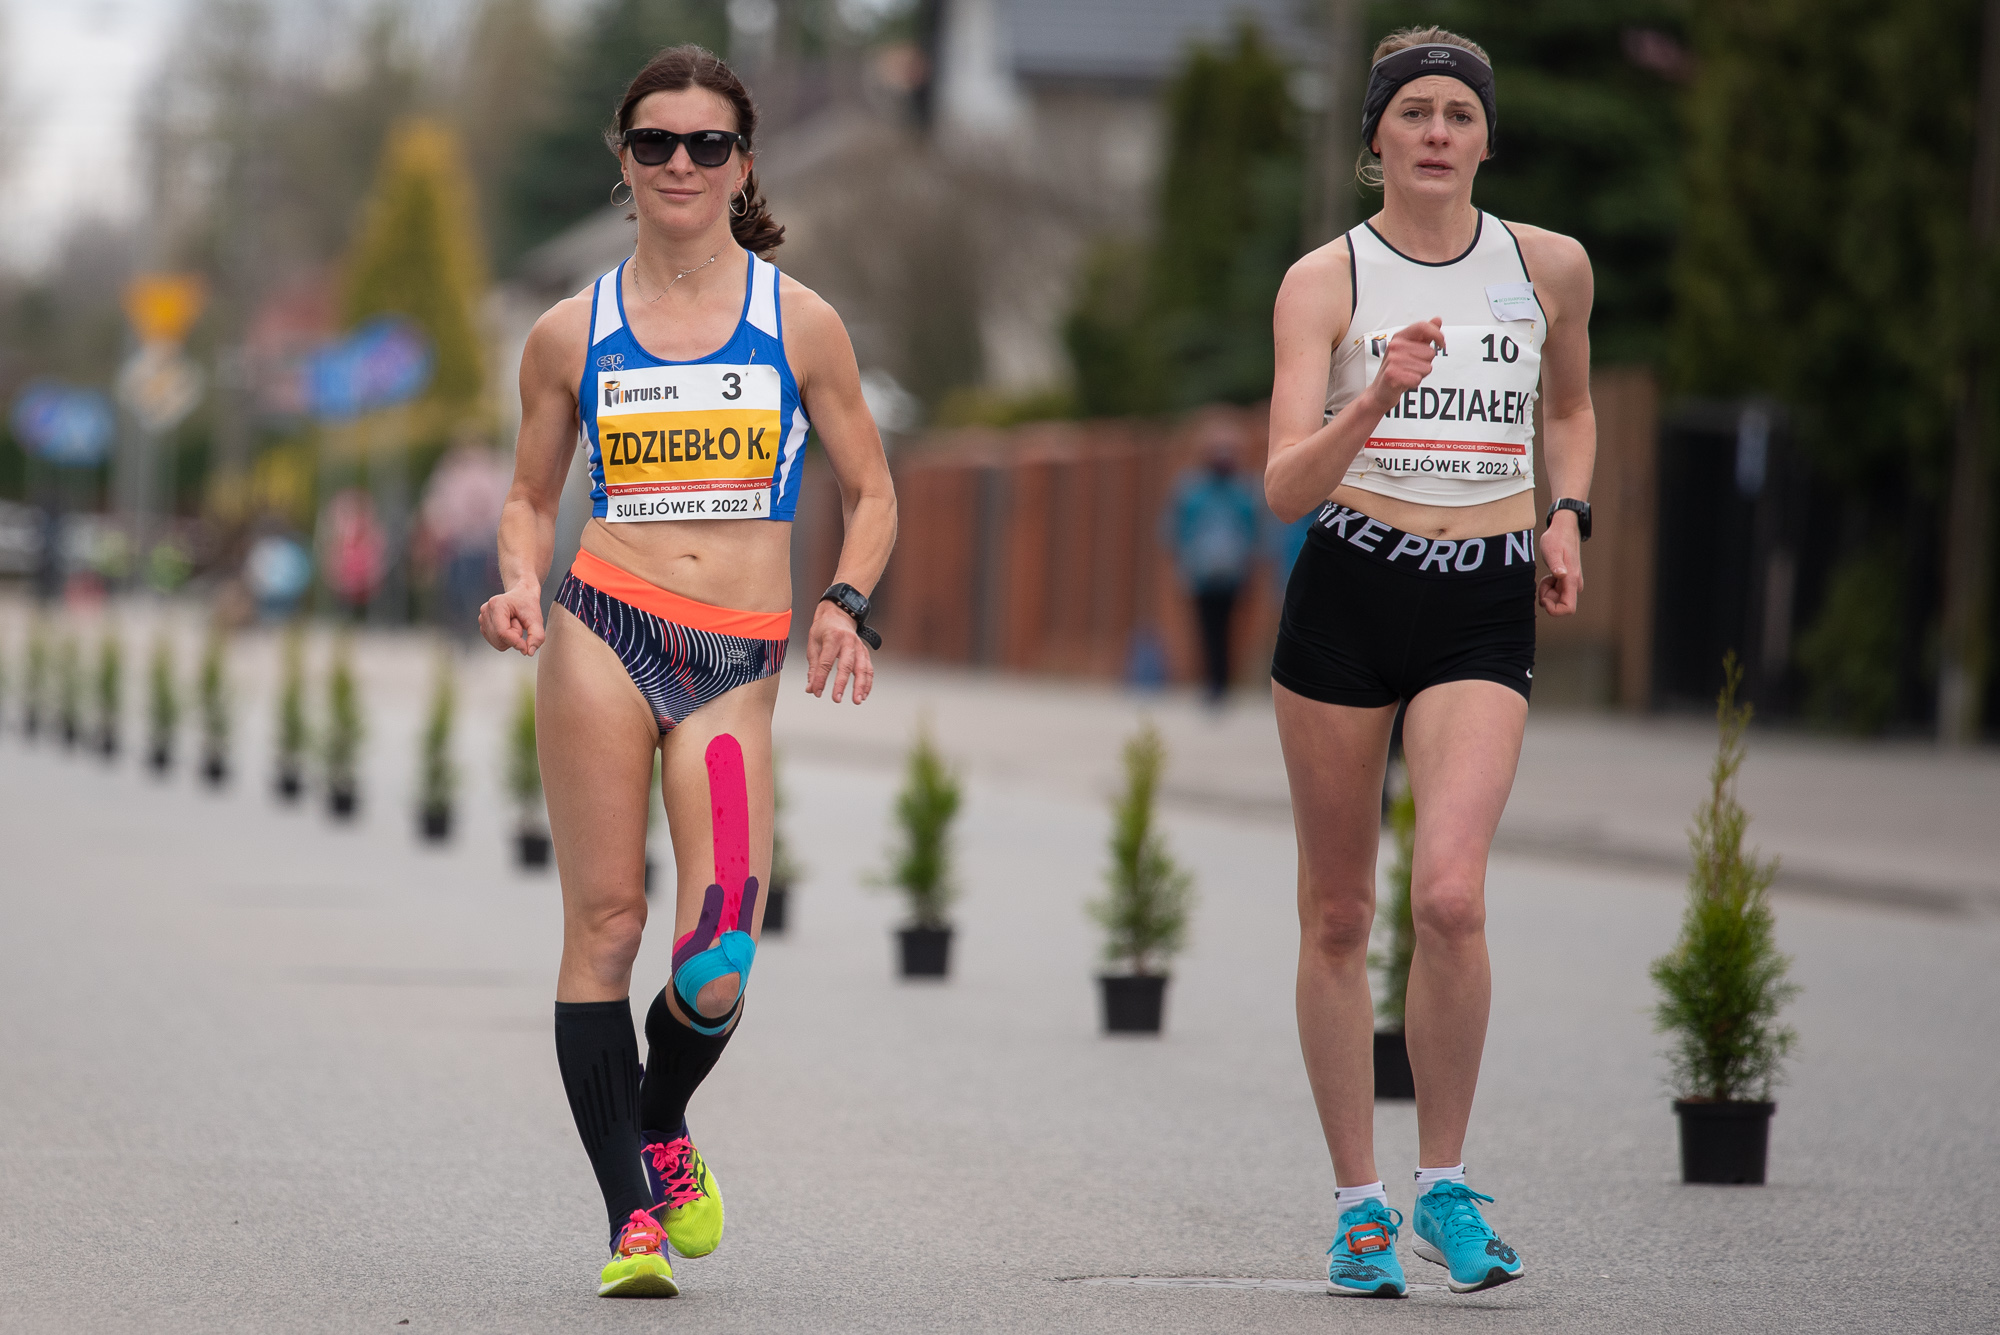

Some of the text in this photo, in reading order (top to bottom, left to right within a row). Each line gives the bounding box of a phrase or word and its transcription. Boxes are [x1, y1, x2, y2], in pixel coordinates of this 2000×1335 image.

[1420, 58, 1457, 67] Kalenji
[1481, 333, 1519, 364] 10
[722, 372, 742, 400] 3
[1384, 387, 1530, 425] IEDZIAŁEK
[606, 427, 771, 466] ZDZIEBŁO K.
[1374, 456, 1509, 476] SULEJÓWEK 2022
[616, 497, 748, 518] SULEJÓWEK 2022
[1387, 532, 1486, 573] PRO
